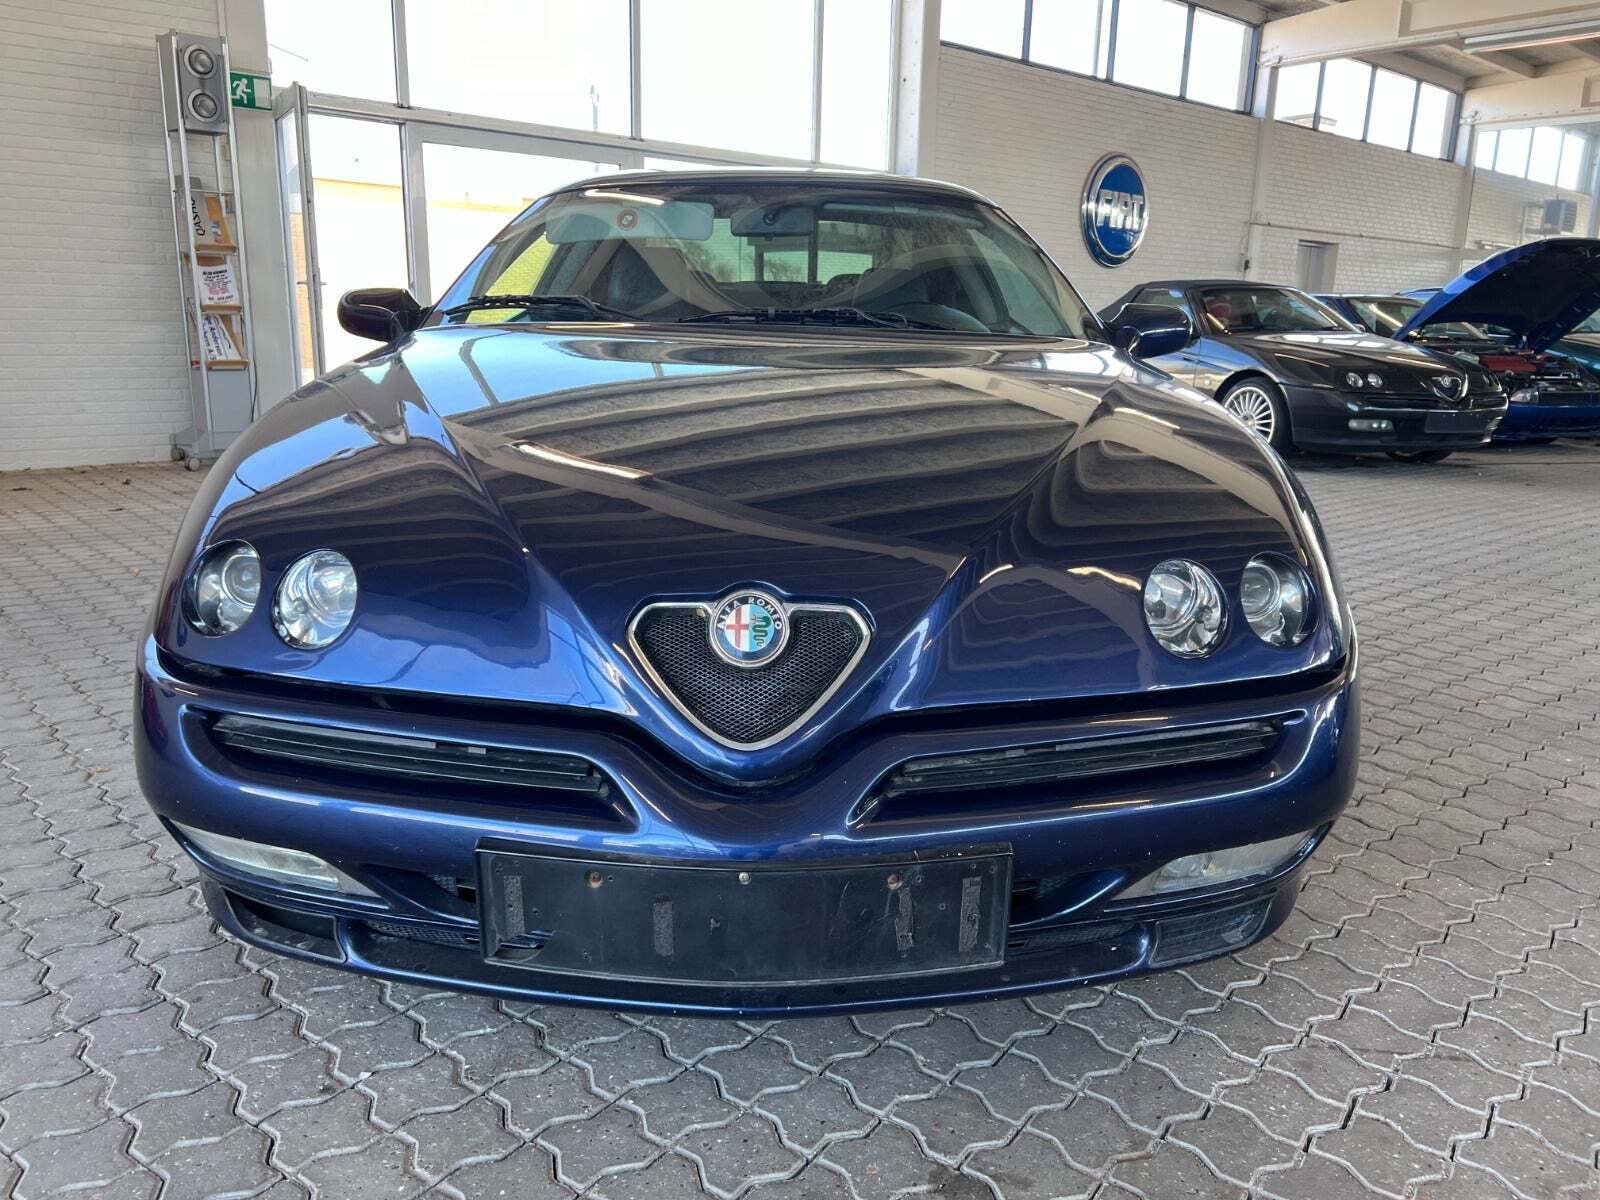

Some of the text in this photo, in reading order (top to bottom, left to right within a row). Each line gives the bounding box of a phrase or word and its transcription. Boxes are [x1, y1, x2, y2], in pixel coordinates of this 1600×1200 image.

[1096, 189, 1144, 231] FIAT
[717, 596, 783, 630] ALFA ROMEO
